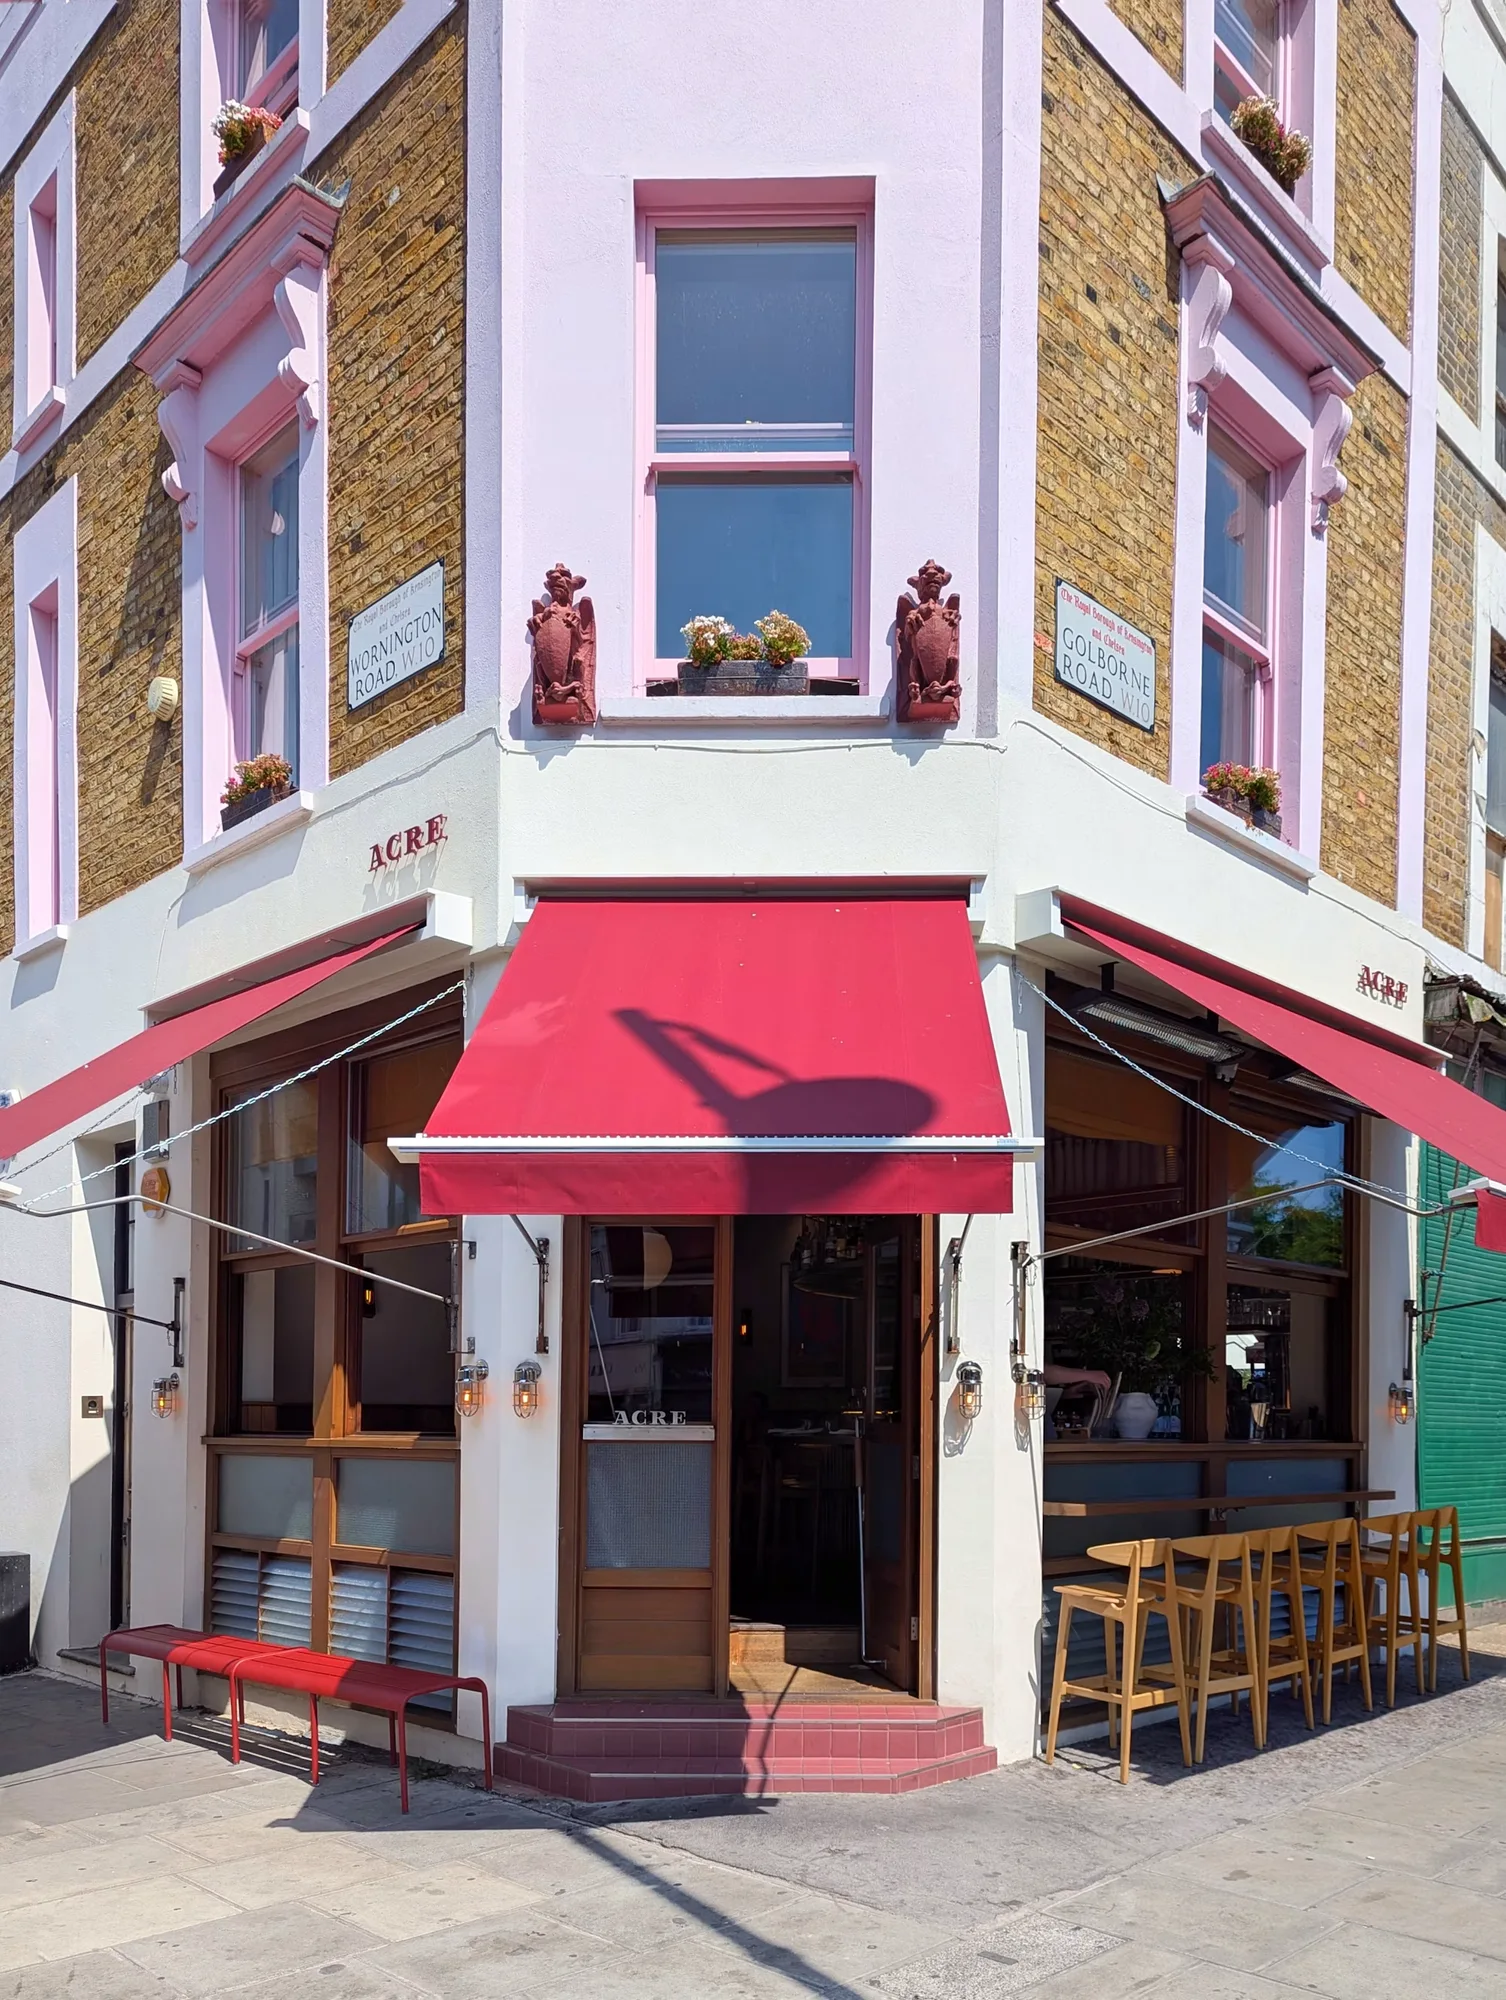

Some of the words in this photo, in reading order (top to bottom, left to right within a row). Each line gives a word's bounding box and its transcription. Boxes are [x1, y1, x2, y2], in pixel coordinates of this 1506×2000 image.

[363, 607, 378, 626] Royal
[379, 594, 401, 615] Borough
[410, 569, 441, 596] Kensington
[350, 603, 441, 677] WORNINGTON
[379, 618, 389, 634] and
[389, 607, 411, 627] Chelsea
[1061, 587, 1073, 604] The
[1074, 594, 1091, 616] Royal
[1092, 607, 1116, 632] Borough
[1117, 624, 1124, 636] of
[1124, 626, 1153, 656] Kensington
[401, 636, 435, 672] W.10
[1092, 628, 1102, 642] and
[1103, 633, 1126, 656] Chelsea
[1062, 627, 1151, 698] GOLBORNE
[1120, 687, 1150, 723] W.10
[368, 813, 448, 873] ACRE
[1358, 964, 1408, 1004] ACRE
[612, 1409, 687, 1425] ACRE
